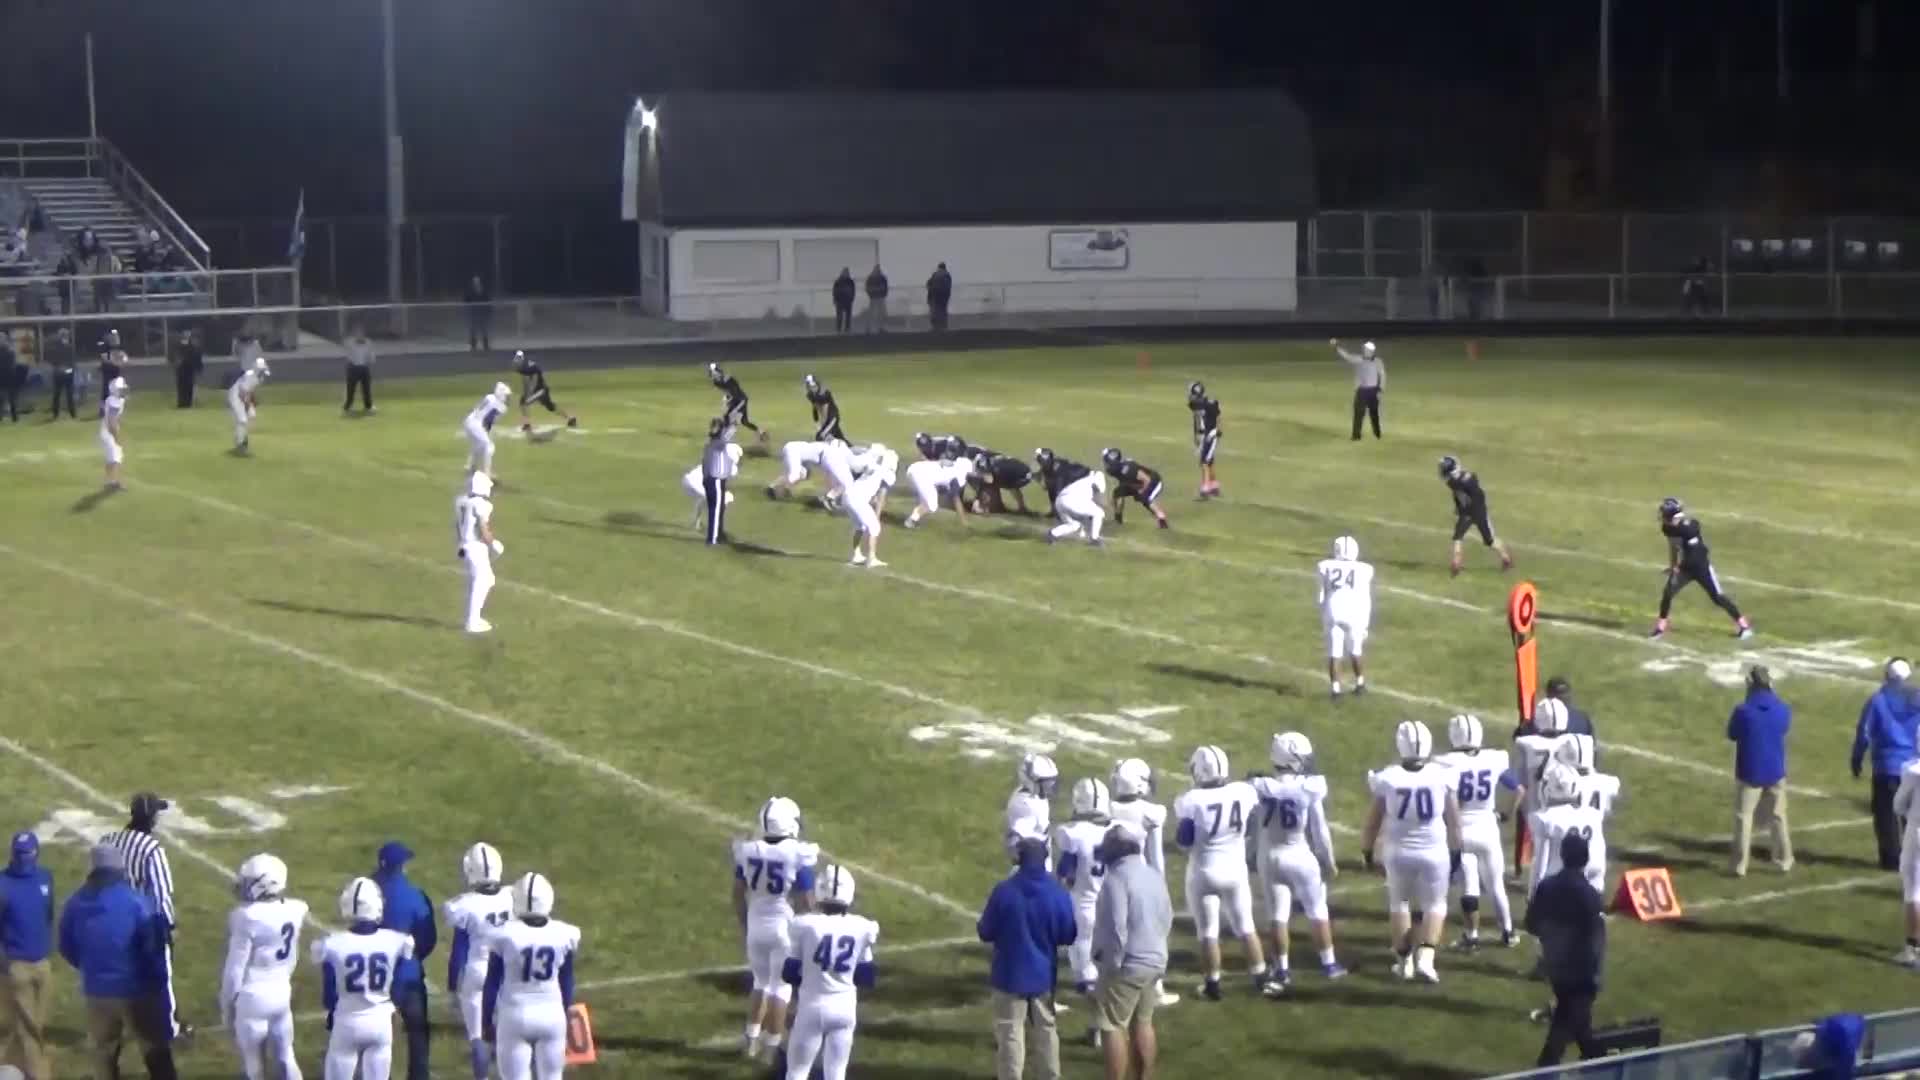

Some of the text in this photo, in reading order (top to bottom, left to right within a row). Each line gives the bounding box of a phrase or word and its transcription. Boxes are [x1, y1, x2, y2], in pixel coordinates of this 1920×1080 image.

[1330, 567, 1355, 590] 24
[1395, 786, 1434, 823] 70
[1457, 768, 1492, 803] 65
[1206, 799, 1243, 837] 74
[1261, 796, 1298, 830] 76
[746, 857, 785, 896] 75
[1632, 874, 1674, 915] 30
[275, 921, 295, 961] 3
[812, 934, 856, 974] 42
[344, 952, 389, 993] 26
[520, 945, 556, 983] 13
[567, 1006, 587, 1052] 0
